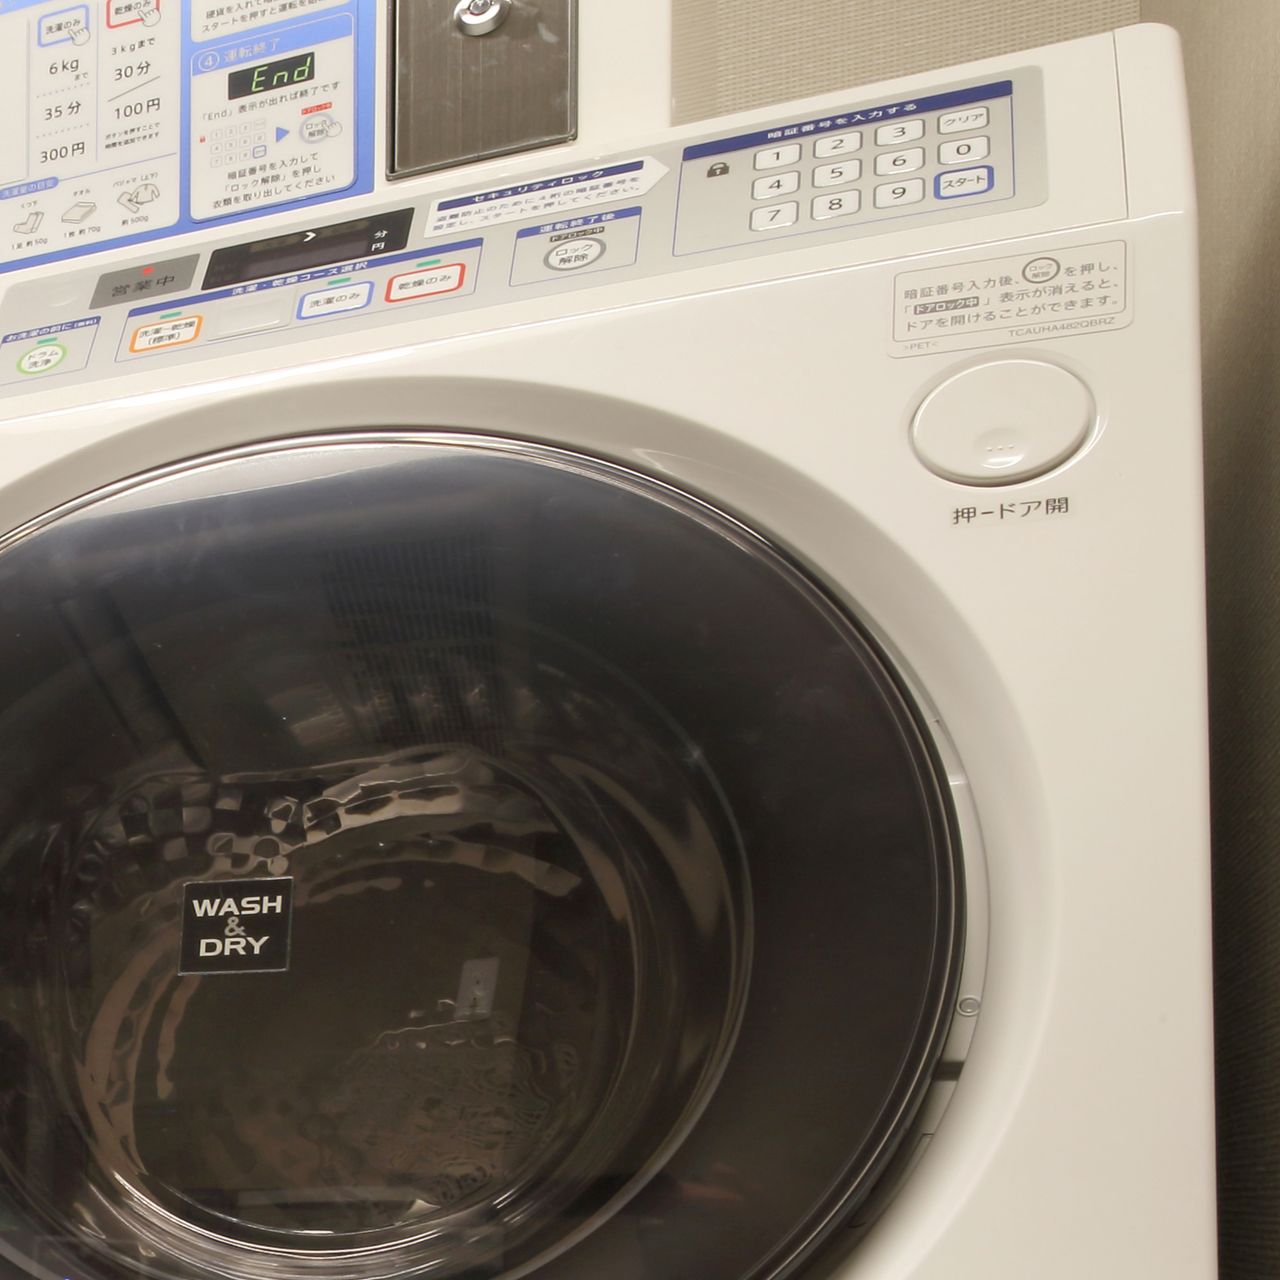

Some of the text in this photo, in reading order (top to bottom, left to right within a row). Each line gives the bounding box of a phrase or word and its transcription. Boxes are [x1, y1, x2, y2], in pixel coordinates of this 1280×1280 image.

[45, 19, 81, 35] 洗濯のみ
[75, 72, 89, 81] まで
[114, 61, 151, 81] 30分
[251, 56, 313, 93] End
[44, 101, 82, 121] 35分
[114, 99, 161, 120] 100円
[767, 102, 918, 140] 暗証番号を入力する
[772, 112, 984, 161] 1 2 3 クリア
[40, 142, 85, 164] 300円
[227, 152, 319, 181] 暗証番号を入力して
[767, 178, 783, 191] 4
[830, 166, 843, 179] 5
[892, 155, 907, 167] 6
[212, 175, 335, 209] 衣類を取り出してください
[473, 169, 605, 203] セキュリティロック
[767, 173, 986, 222] 7 8 9 スタート
[539, 213, 616, 233] 運転終了後
[373, 229, 388, 240] 分
[371, 241, 385, 251] 円
[555, 242, 594, 257] ロック
[558, 252, 590, 266] 解除
[111, 274, 176, 297] 営業中
[397, 273, 453, 291] 乾燥のみ
[904, 273, 1019, 300] 暗証番号入力後、
[1064, 261, 1118, 277] を押し、
[308, 291, 362, 309] 洗濯のみ
[906, 294, 1118, 332] ドアを開けることができます。
[26, 348, 60, 361] ドラム
[28, 358, 53, 369] 洗浄
[192, 895, 282, 917] WASH
[224, 916, 247, 936] &
[200, 936, 270, 956] DRY
